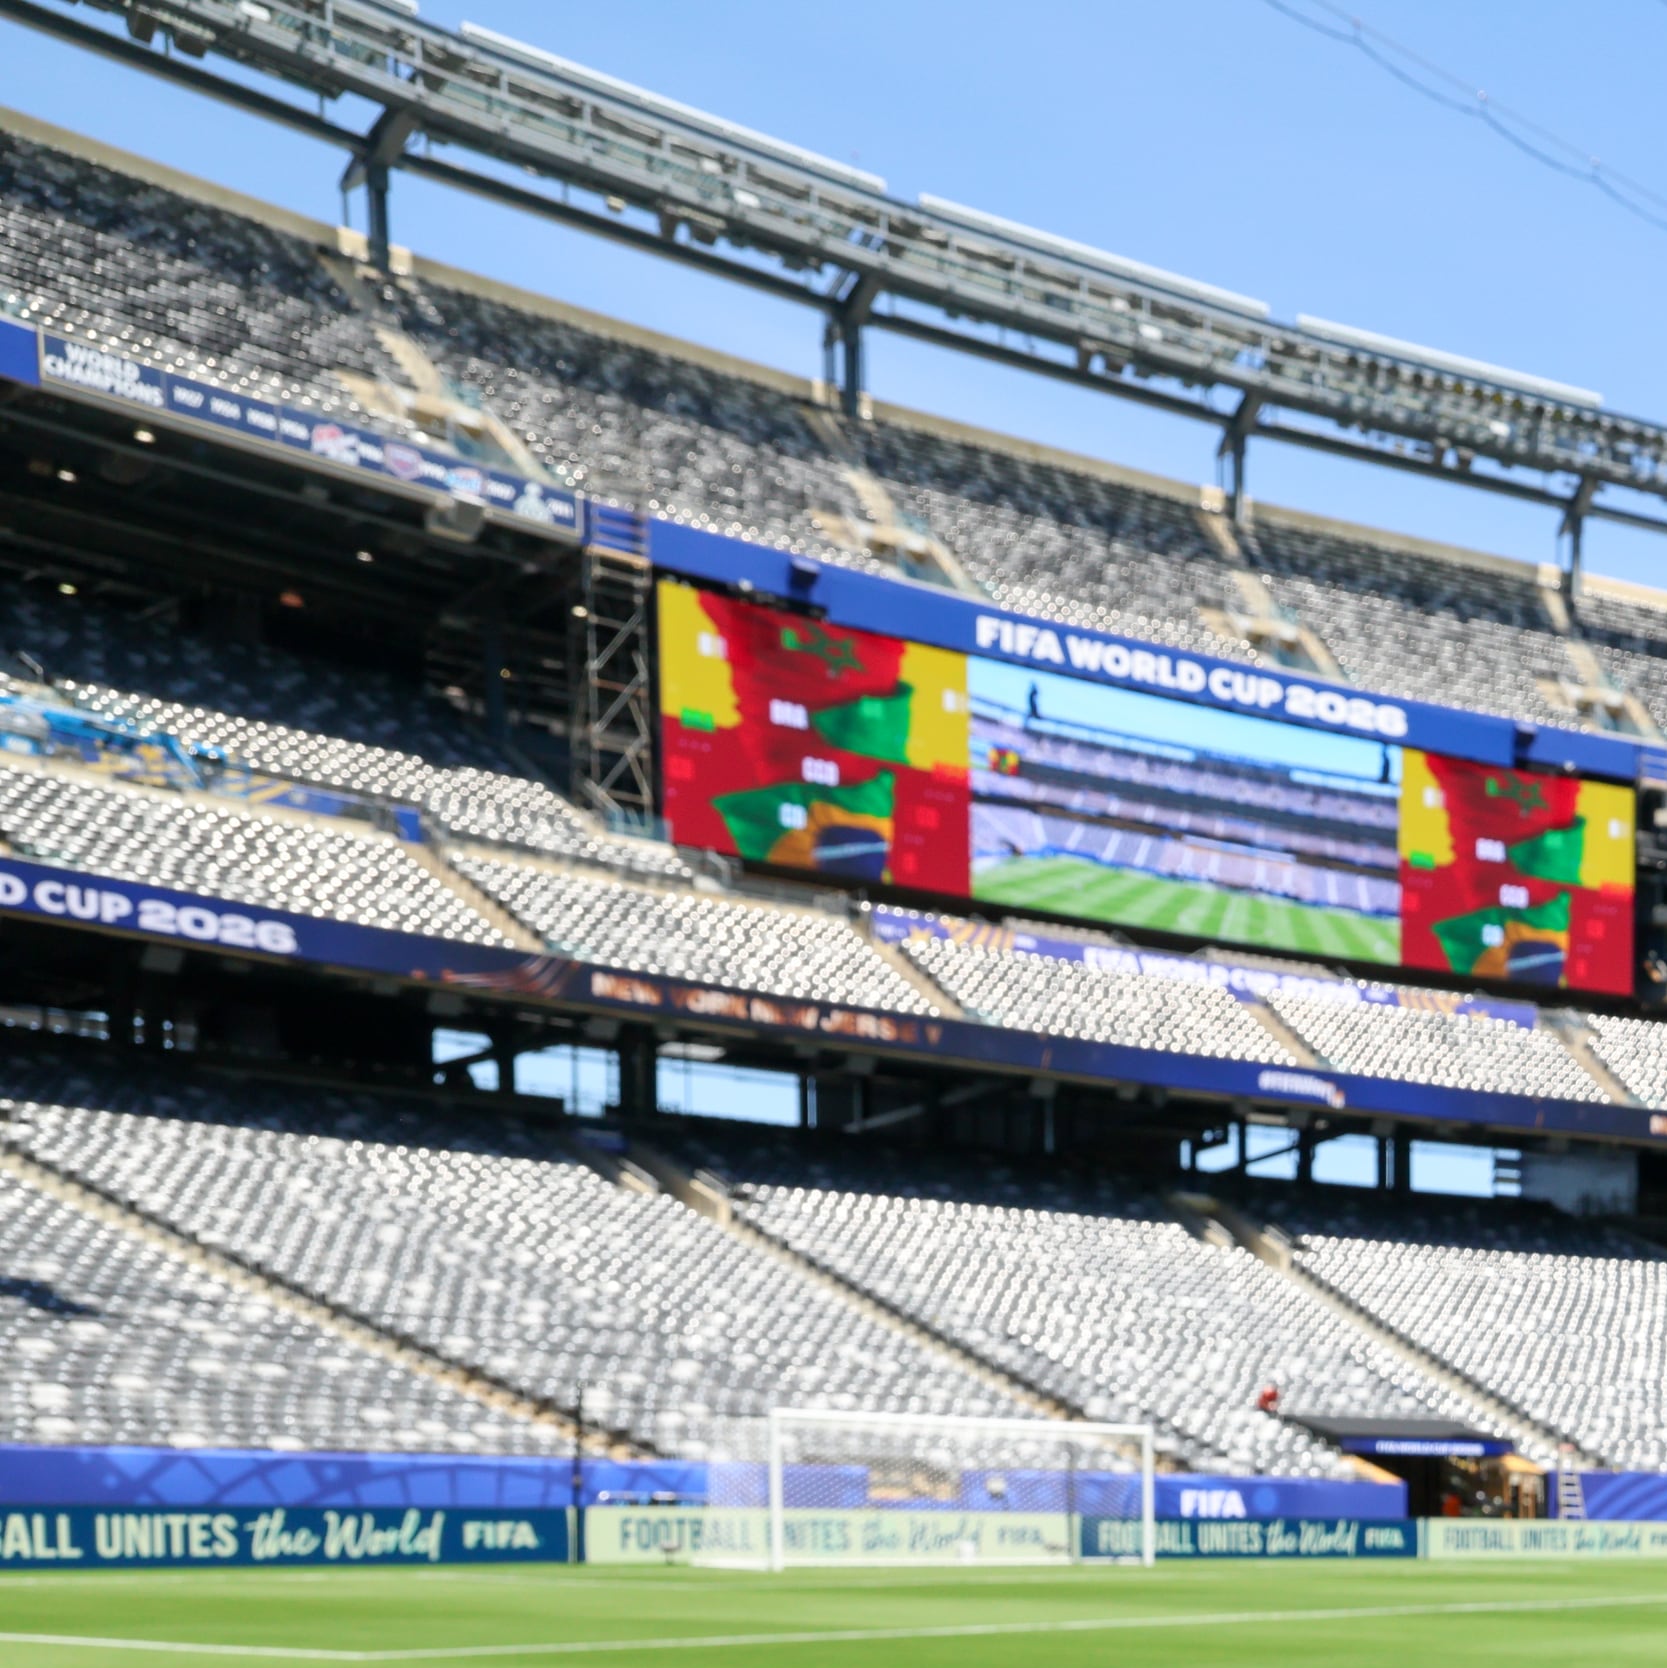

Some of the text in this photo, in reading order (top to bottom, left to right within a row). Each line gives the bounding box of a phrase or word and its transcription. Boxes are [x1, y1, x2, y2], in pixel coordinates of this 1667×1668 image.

[43, 353, 164, 407] CHAMPIONS
[64, 342, 141, 382] WORLD
[976, 615, 1409, 737] FIFA WORLD CUP 2026
[33, 880, 133, 923] CUP
[137, 899, 299, 954] 2026
[1180, 1489, 1247, 1518] FIFA
[0, 1507, 541, 1562] ALL UNITES the World FIFA
[1198, 1520, 1264, 1555] UNITES
[1263, 1519, 1297, 1556] the
[1299, 1519, 1360, 1556] World
[1364, 1527, 1404, 1549] FIFA
[1443, 1526, 1514, 1551] FOOTBALL
[1520, 1526, 1567, 1551] UNITES
